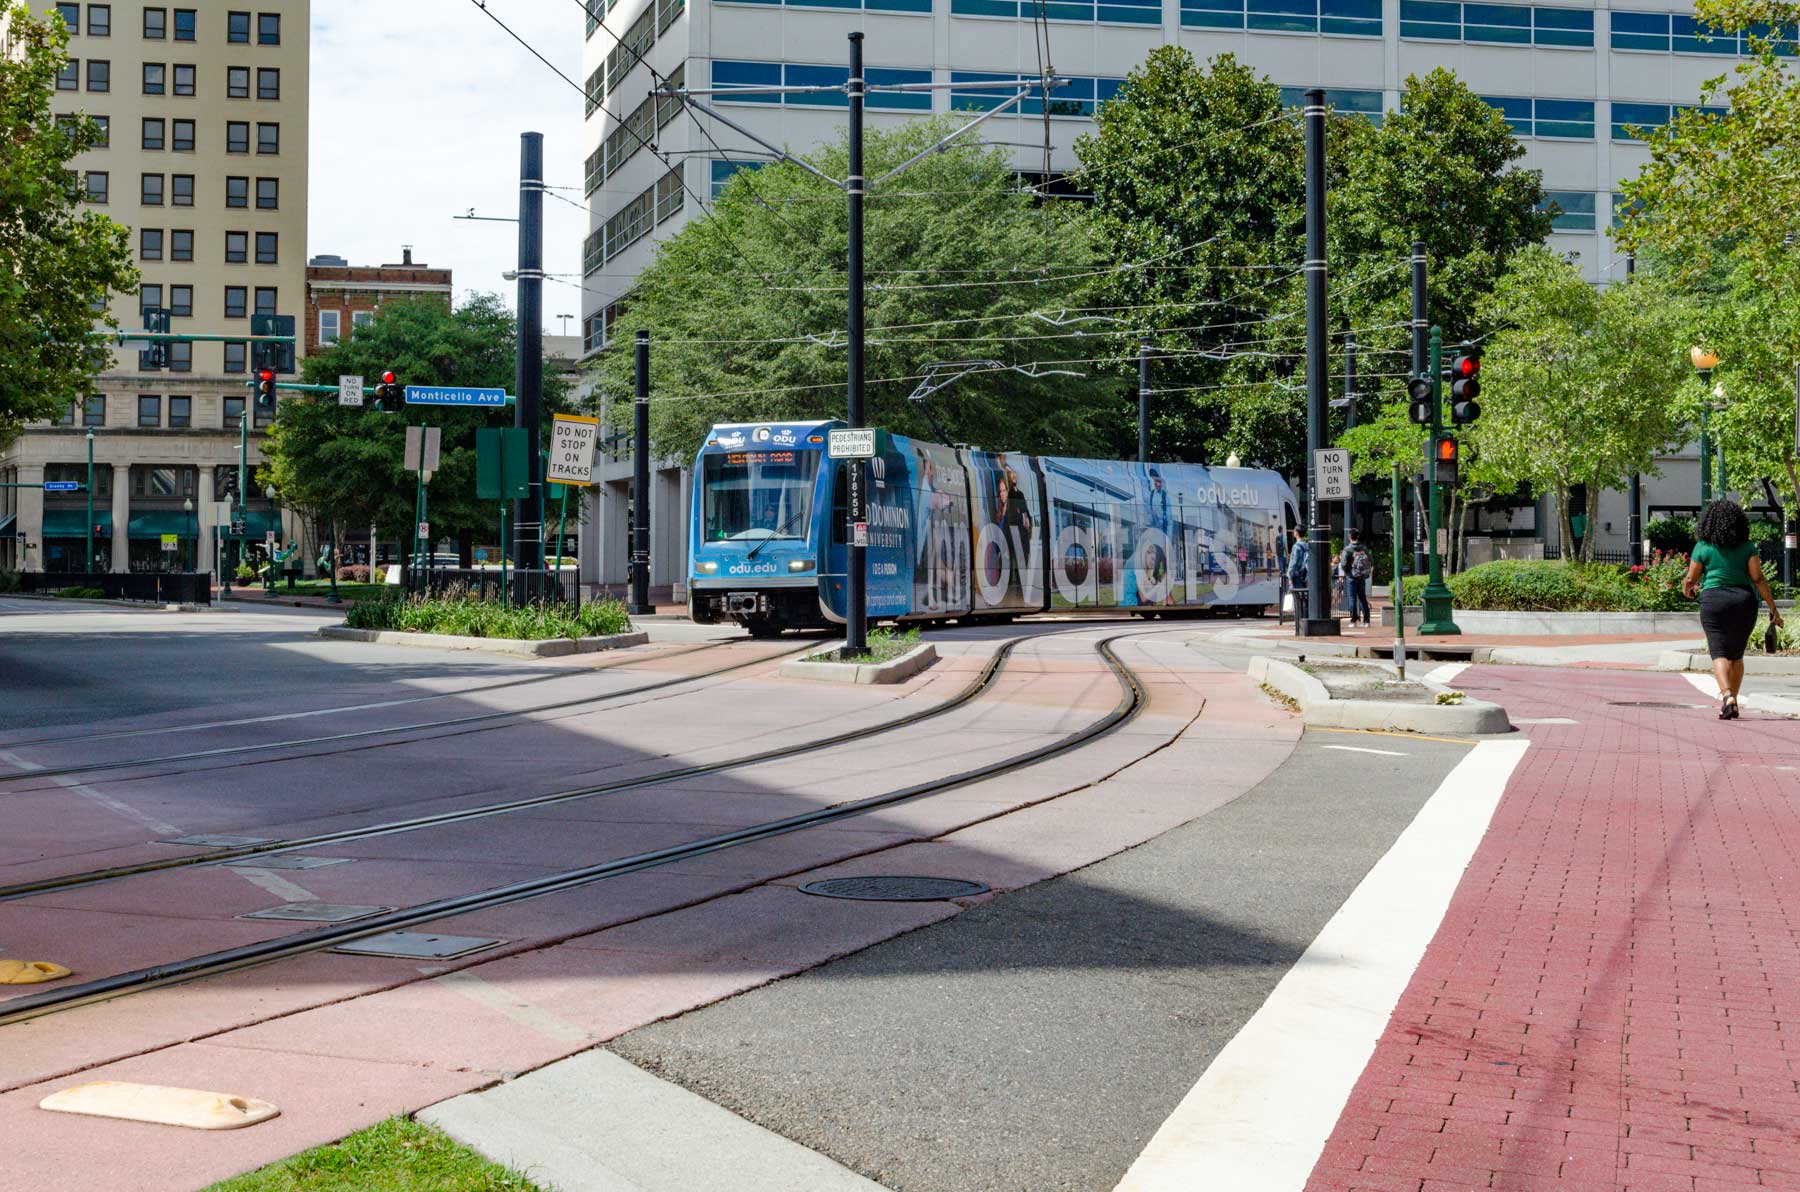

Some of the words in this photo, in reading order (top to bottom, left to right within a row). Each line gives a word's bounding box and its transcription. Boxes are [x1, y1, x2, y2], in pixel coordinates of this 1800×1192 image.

[411, 390, 472, 401] Monticello
[478, 393, 500, 402] Ave
[557, 426, 571, 436] DO
[574, 428, 593, 438] NOT
[773, 434, 796, 444] ODU
[831, 433, 872, 442] PEDESTRIANS
[560, 440, 586, 450] STOP
[832, 443, 871, 453] PROHIBITED
[564, 452, 579, 463] ON
[1324, 453, 1340, 463] NO
[552, 463, 589, 476] TRACKS
[1322, 465, 1343, 474] TURN
[1327, 476, 1339, 484] ON
[1197, 482, 1259, 506] odu.edu
[1325, 486, 1341, 495] RED
[872, 502, 910, 528] DOMINION
[729, 562, 777, 574] odu.edu
